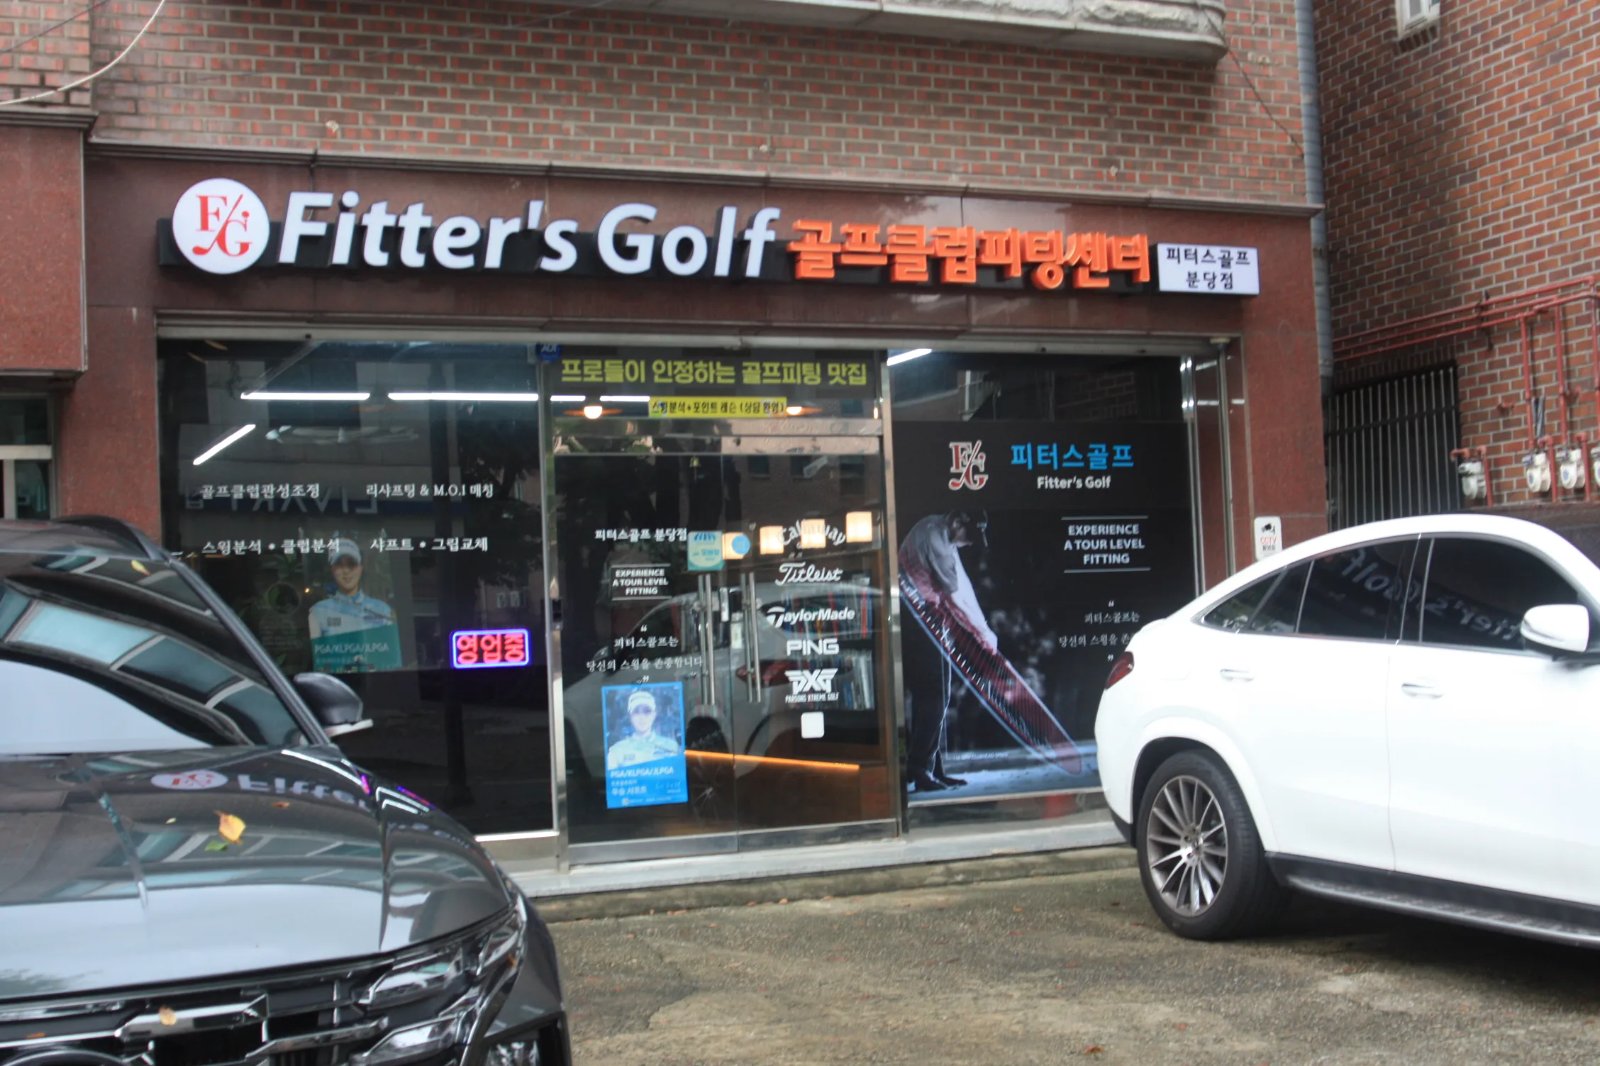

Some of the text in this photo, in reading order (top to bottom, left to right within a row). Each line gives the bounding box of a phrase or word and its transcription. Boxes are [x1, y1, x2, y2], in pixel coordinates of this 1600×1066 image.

[278, 190, 781, 278] Fitter's Golf
[1166, 247, 1250, 269] 피터스골프
[1186, 271, 1233, 290] 분당점
[561, 359, 867, 386] 프로들이 인정하는 골프피팅 맛집
[1010, 442, 1134, 471] 피터스골프
[420, 484, 429, 497] &
[469, 483, 494, 498] 매칭
[1037, 475, 1112, 489] Fitter's Golf
[594, 528, 688, 543] 피터스골프 분당점
[779, 519, 846, 547] Calway
[1068, 524, 1140, 536] EXPERIENCE
[201, 537, 488, 556] 스윙분석 클럽분석 샤프트 그립교체
[1064, 538, 1145, 551] A TOUR LEVEL
[1083, 553, 1130, 565] FITTING
[612, 577, 668, 587] A TOUR LEVEL
[615, 568, 665, 578] EXPERIENCE
[775, 561, 844, 586] Titleist
[625, 586, 658, 596] FITTING
[766, 601, 856, 629] TaylorMade
[456, 632, 525, 665] 영업중
[786, 638, 840, 656] PING
[1059, 634, 1087, 649] 당신의
